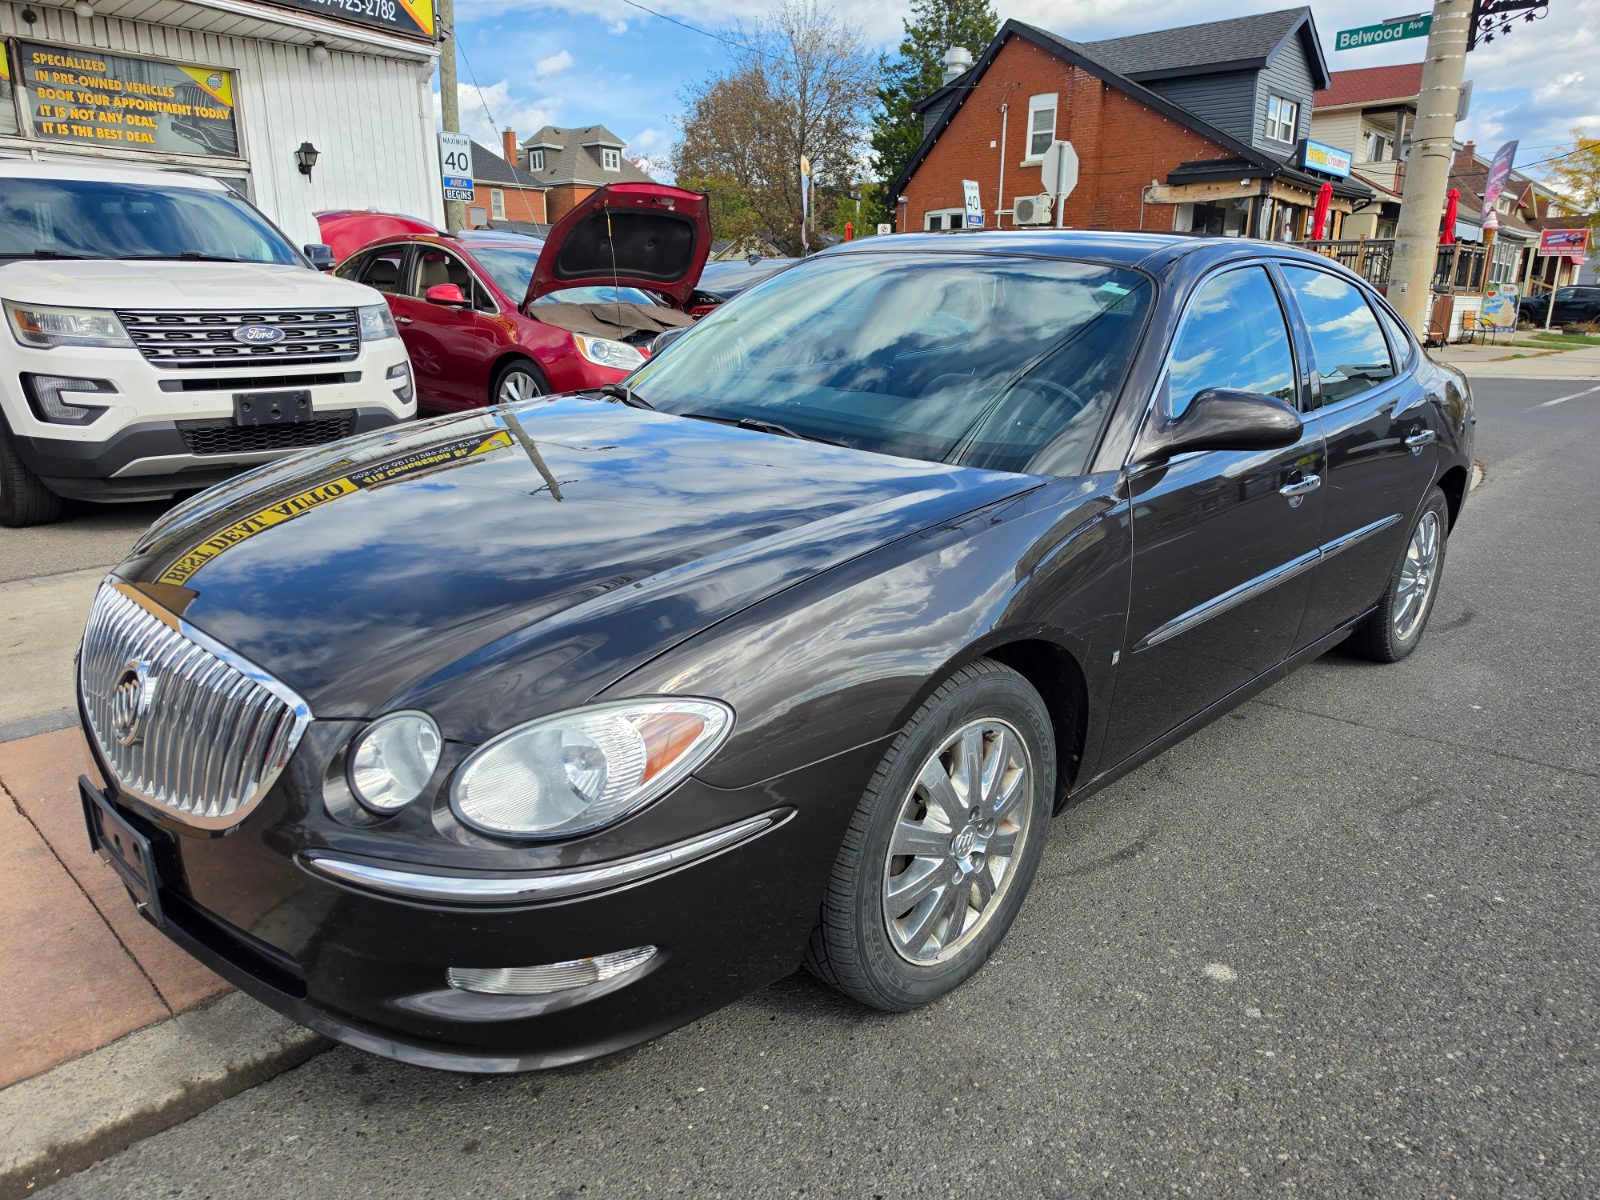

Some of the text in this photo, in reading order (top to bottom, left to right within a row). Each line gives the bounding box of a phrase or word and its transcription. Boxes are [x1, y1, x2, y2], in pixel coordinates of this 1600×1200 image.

[1339, 20, 1424, 48] Belwood Ave
[33, 52, 106, 72] SPECIALIZED
[34, 69, 175, 98] IN PRE-OWNED VEHICLES
[37, 87, 230, 121] BOOK YOUR APPOINTMENT TODAY
[39, 104, 159, 130] IT IS NOT ANY DEAL,
[42, 122, 155, 144] IT IS THE BEST DEAL
[442, 137, 468, 146] MAXIMUM
[444, 151, 469, 171] 40
[449, 179, 468, 187] AREA
[446, 189, 472, 200] BEGINS
[967, 195, 979, 210] 40
[247, 327, 275, 339] Ford
